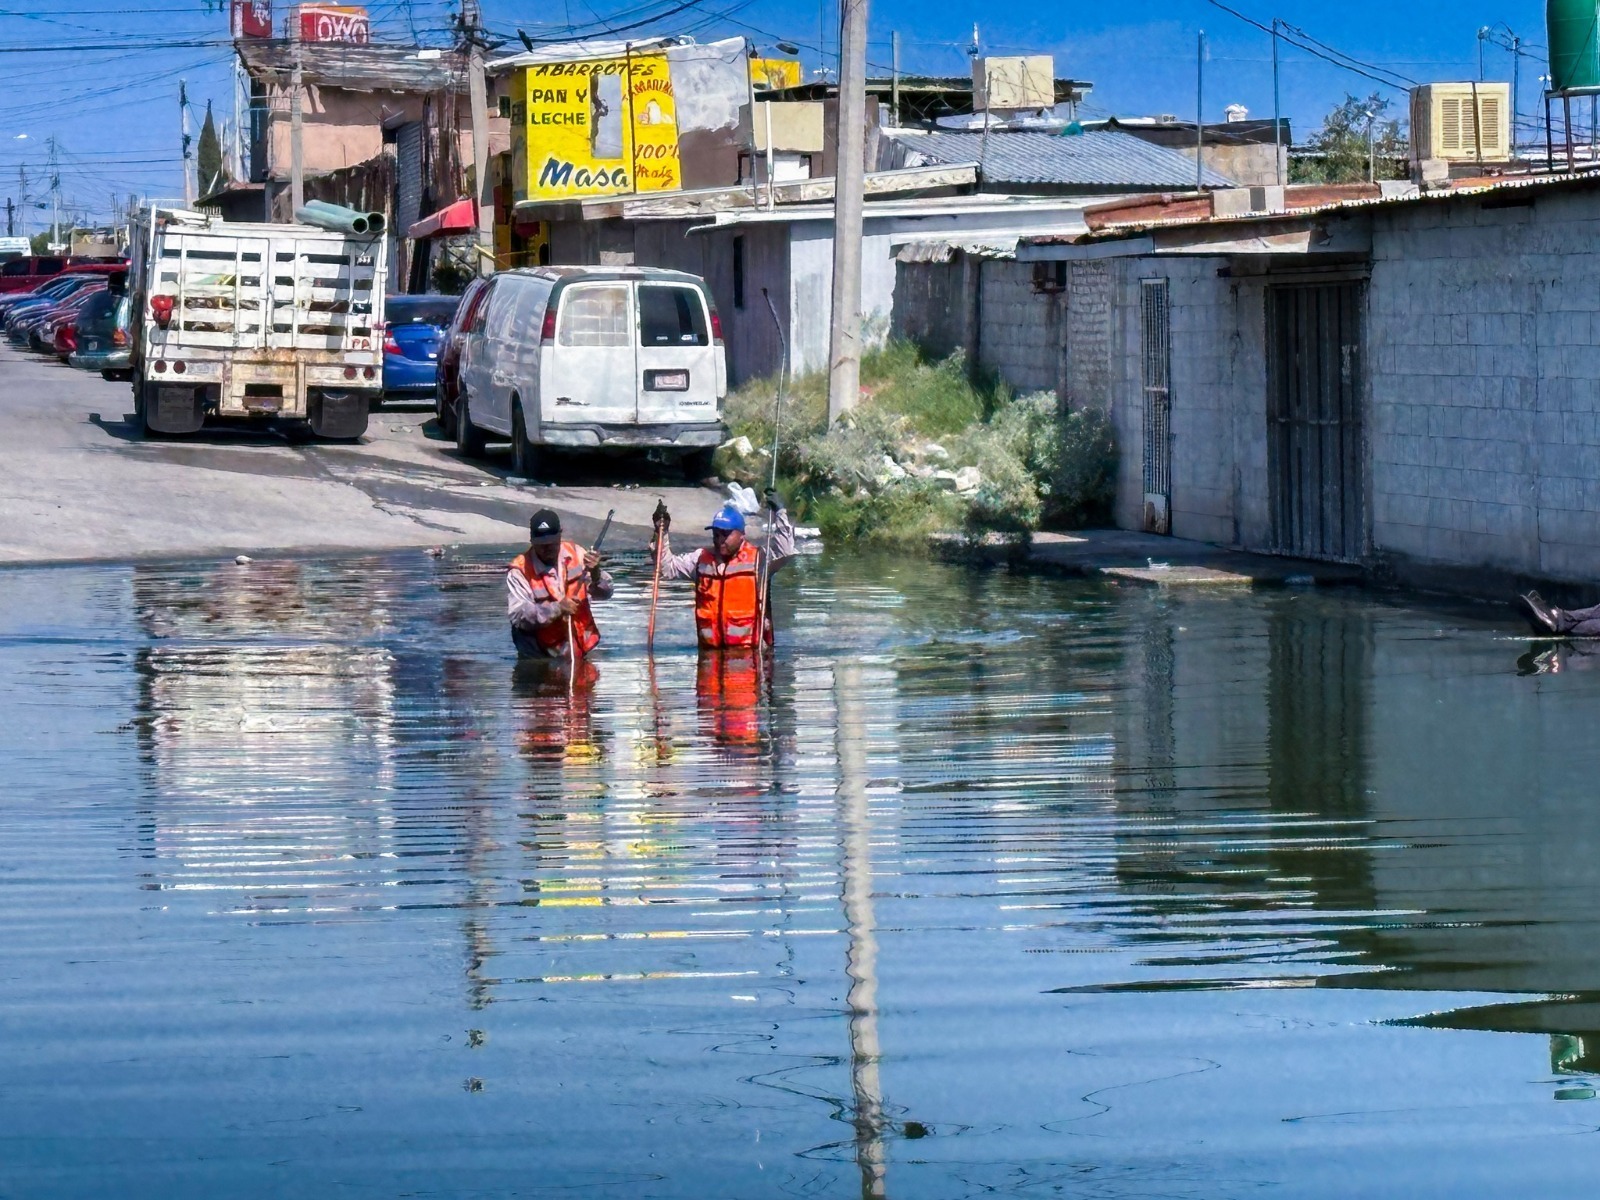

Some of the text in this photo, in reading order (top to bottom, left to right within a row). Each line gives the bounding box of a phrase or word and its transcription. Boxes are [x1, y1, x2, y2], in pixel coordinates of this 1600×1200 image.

[536, 62, 656, 76] ABARROTES
[533, 89, 587, 103] PAN Y
[531, 112, 586, 125] LECHE
[539, 157, 630, 188] Masa
